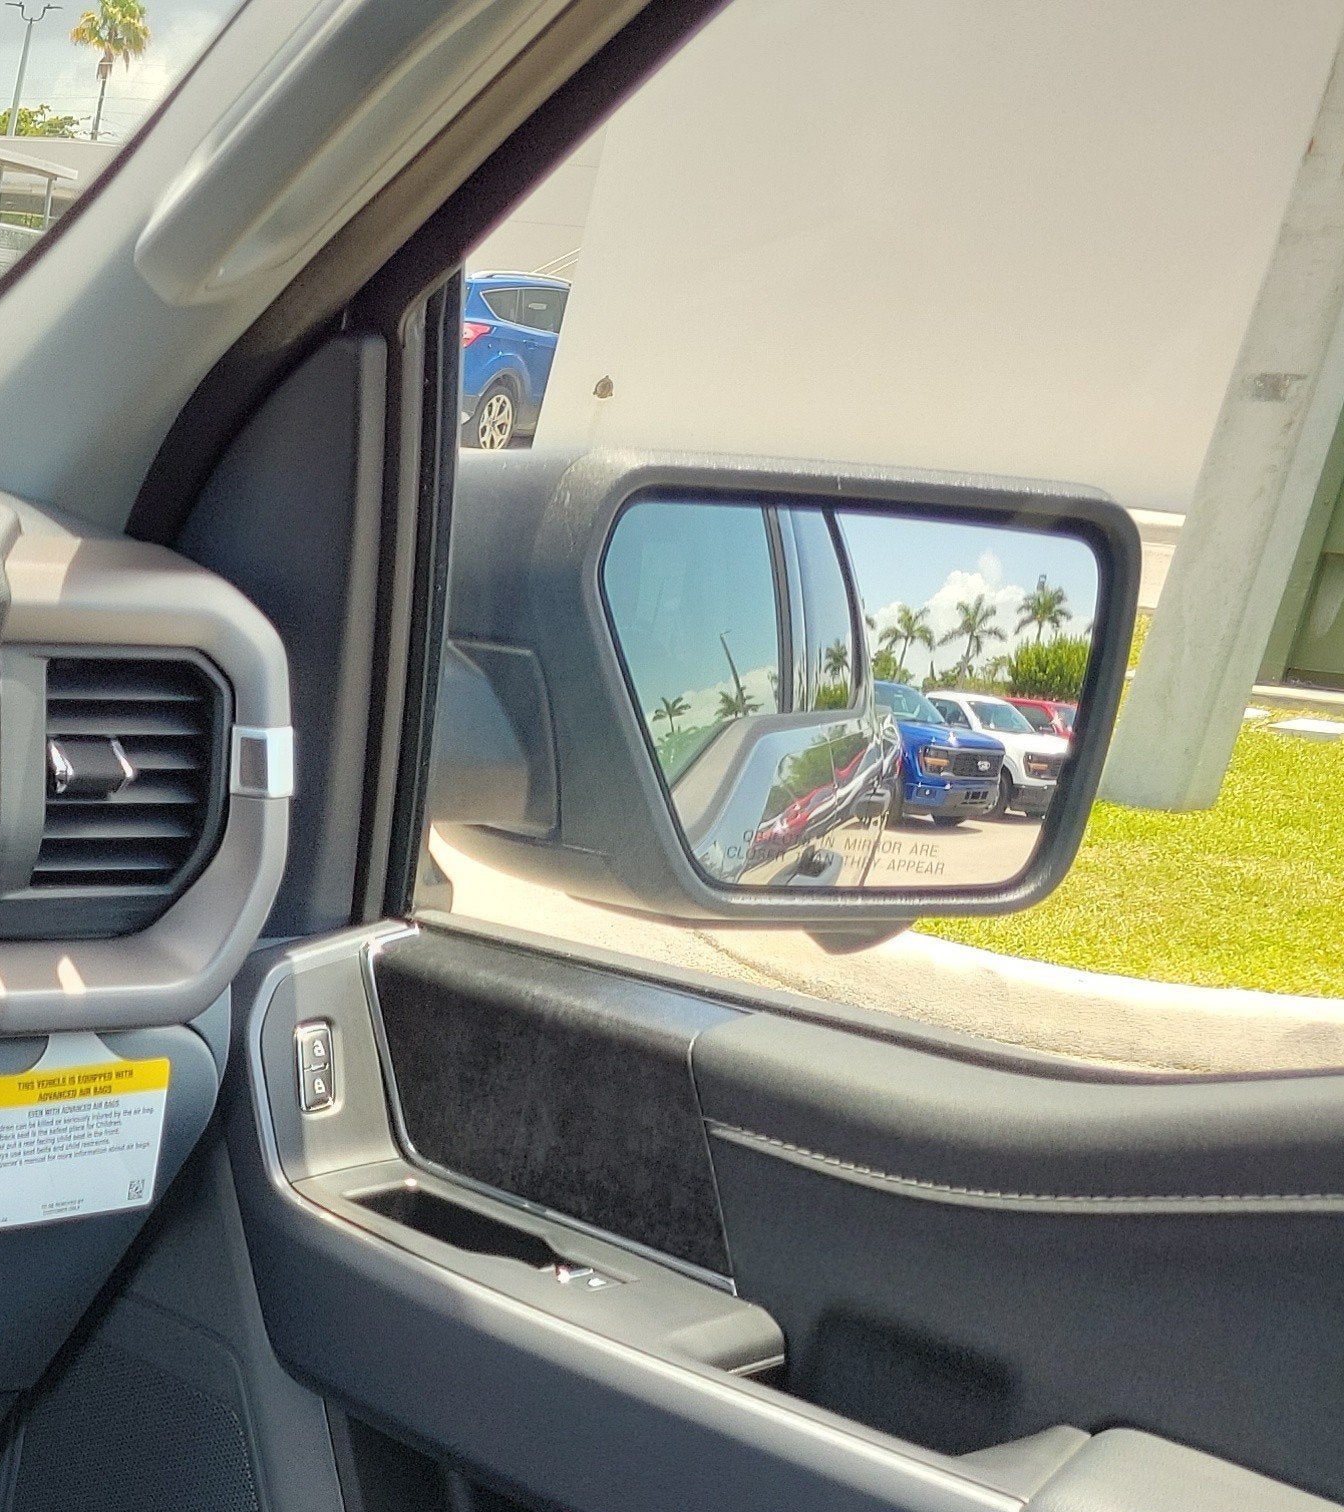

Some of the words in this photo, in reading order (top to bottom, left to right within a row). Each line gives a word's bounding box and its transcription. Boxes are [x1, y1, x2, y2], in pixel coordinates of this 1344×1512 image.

[820, 835, 835, 848] IN
[911, 843, 940, 857] ARE
[795, 850, 835, 867] TAN
[887, 860, 945, 875] APPEAR
